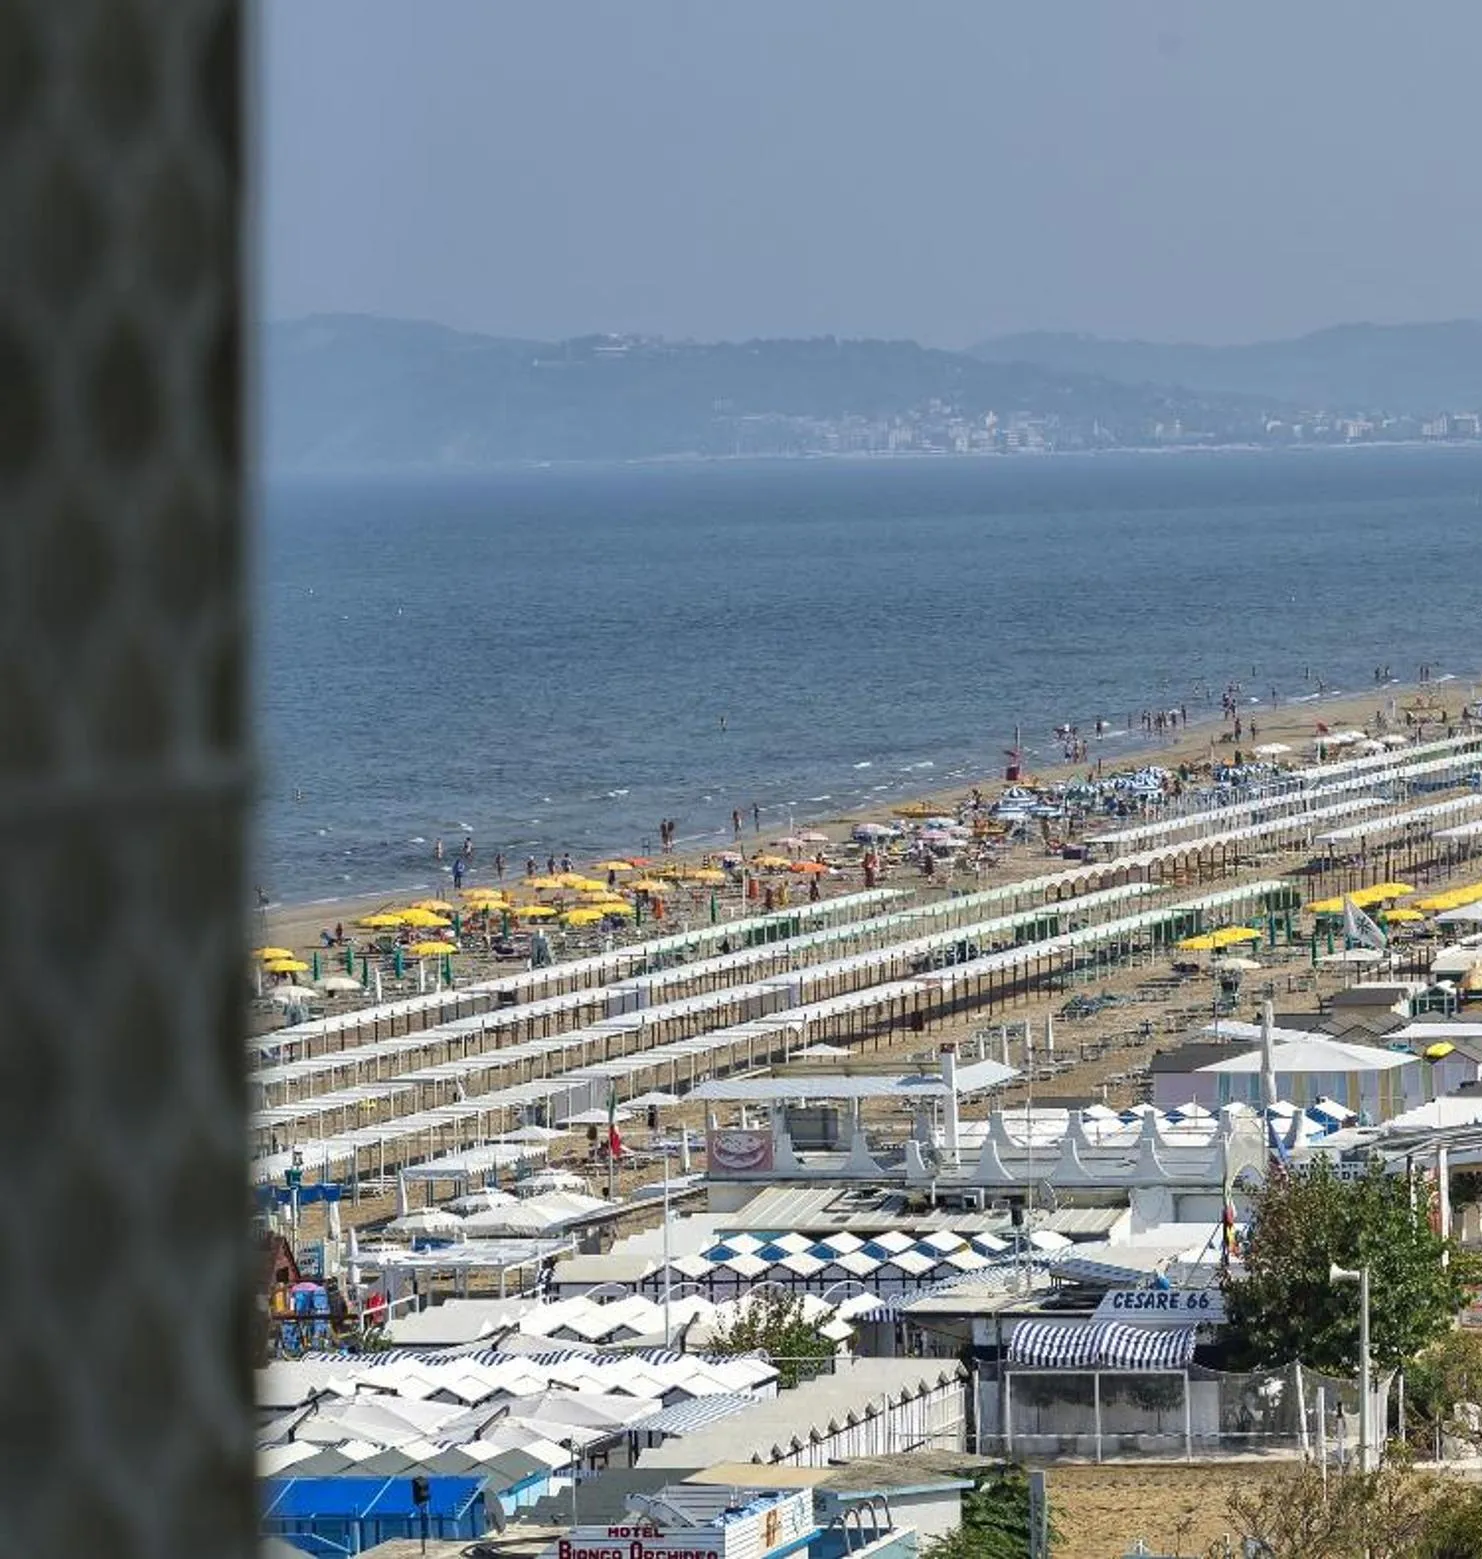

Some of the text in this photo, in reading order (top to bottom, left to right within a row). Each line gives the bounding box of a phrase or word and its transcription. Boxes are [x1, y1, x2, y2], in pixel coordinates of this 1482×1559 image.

[1113, 1292, 1210, 1310] CESARE 66
[608, 1526, 665, 1538] HOTEL
